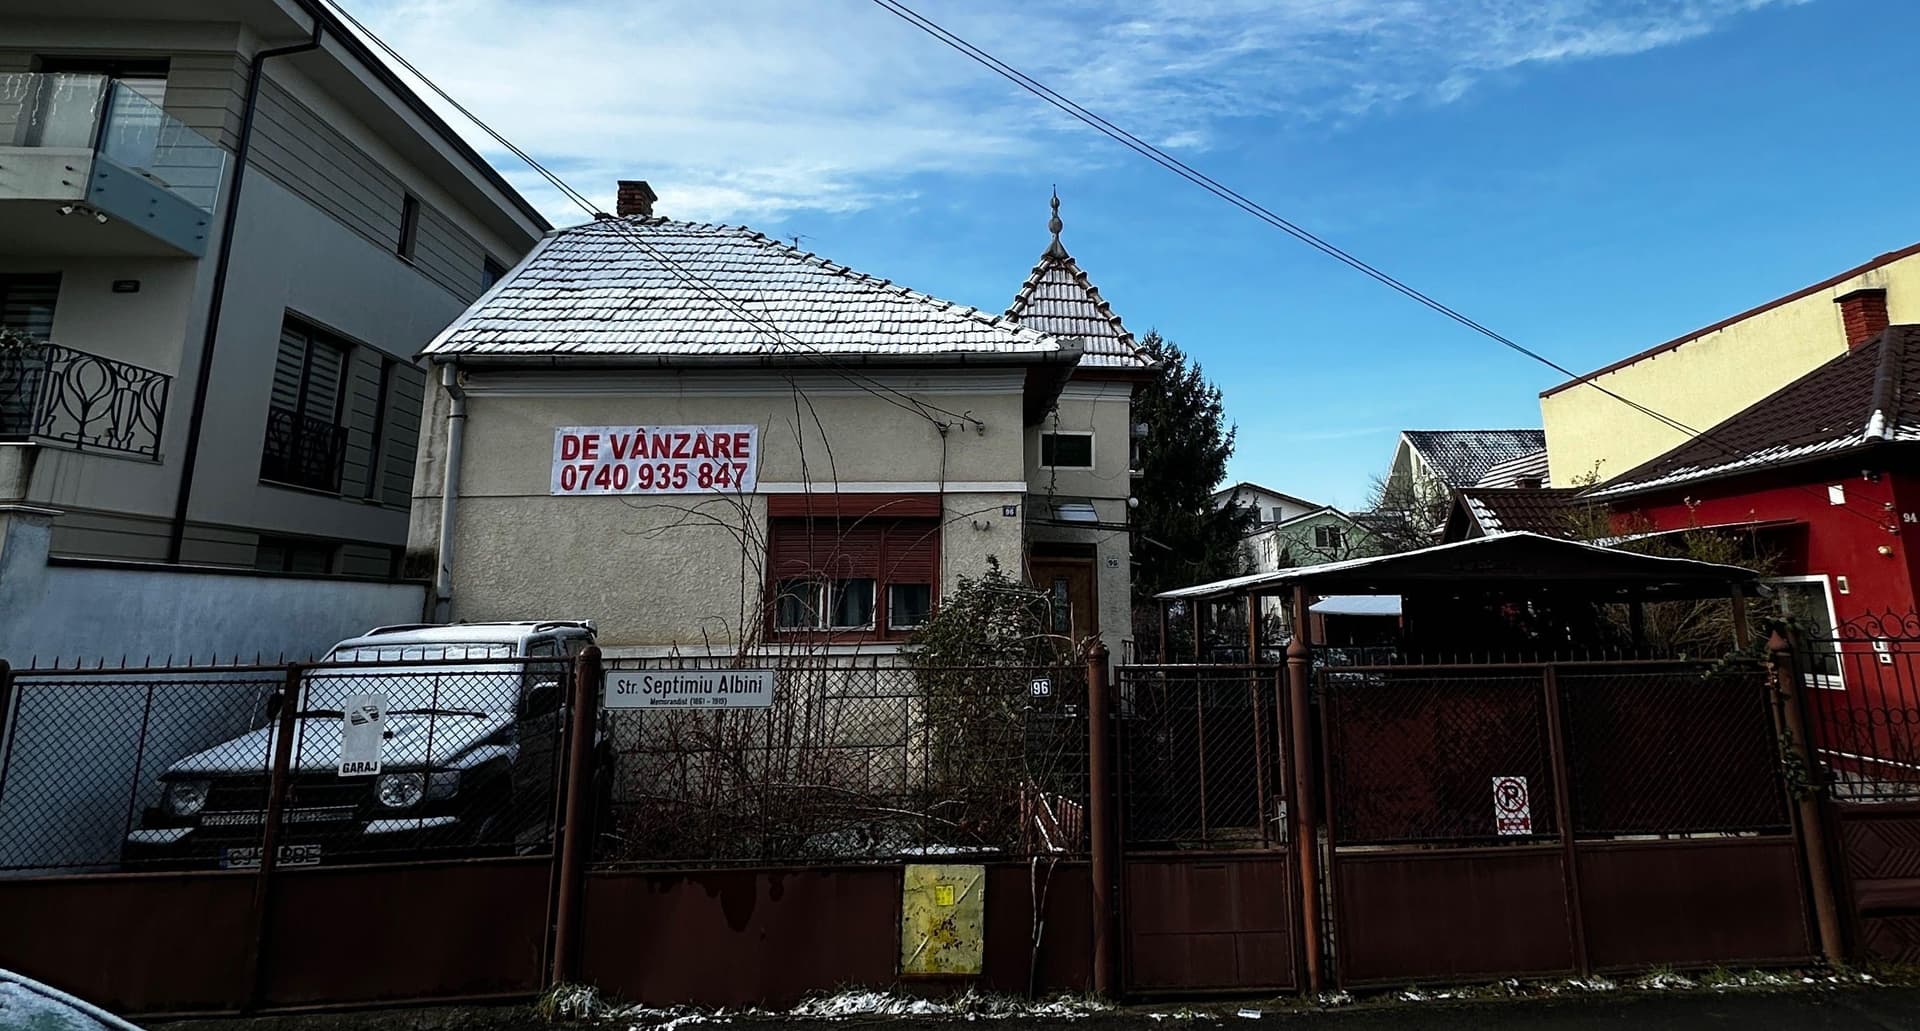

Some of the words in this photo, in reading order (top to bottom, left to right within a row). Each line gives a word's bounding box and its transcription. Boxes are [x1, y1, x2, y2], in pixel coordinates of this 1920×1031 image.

[561, 434, 600, 460] DE
[610, 427, 750, 460] VÂNZARE
[561, 464, 628, 490] 0740
[638, 463, 688, 489] 935
[698, 462, 748, 489] 847
[1903, 512, 1918, 522] 94
[617, 679, 638, 695] Str.
[643, 675, 713, 698] Septimiu
[718, 675, 762, 694] Albini
[1033, 682, 1048, 695] 96
[342, 761, 378, 774] GARAJ
